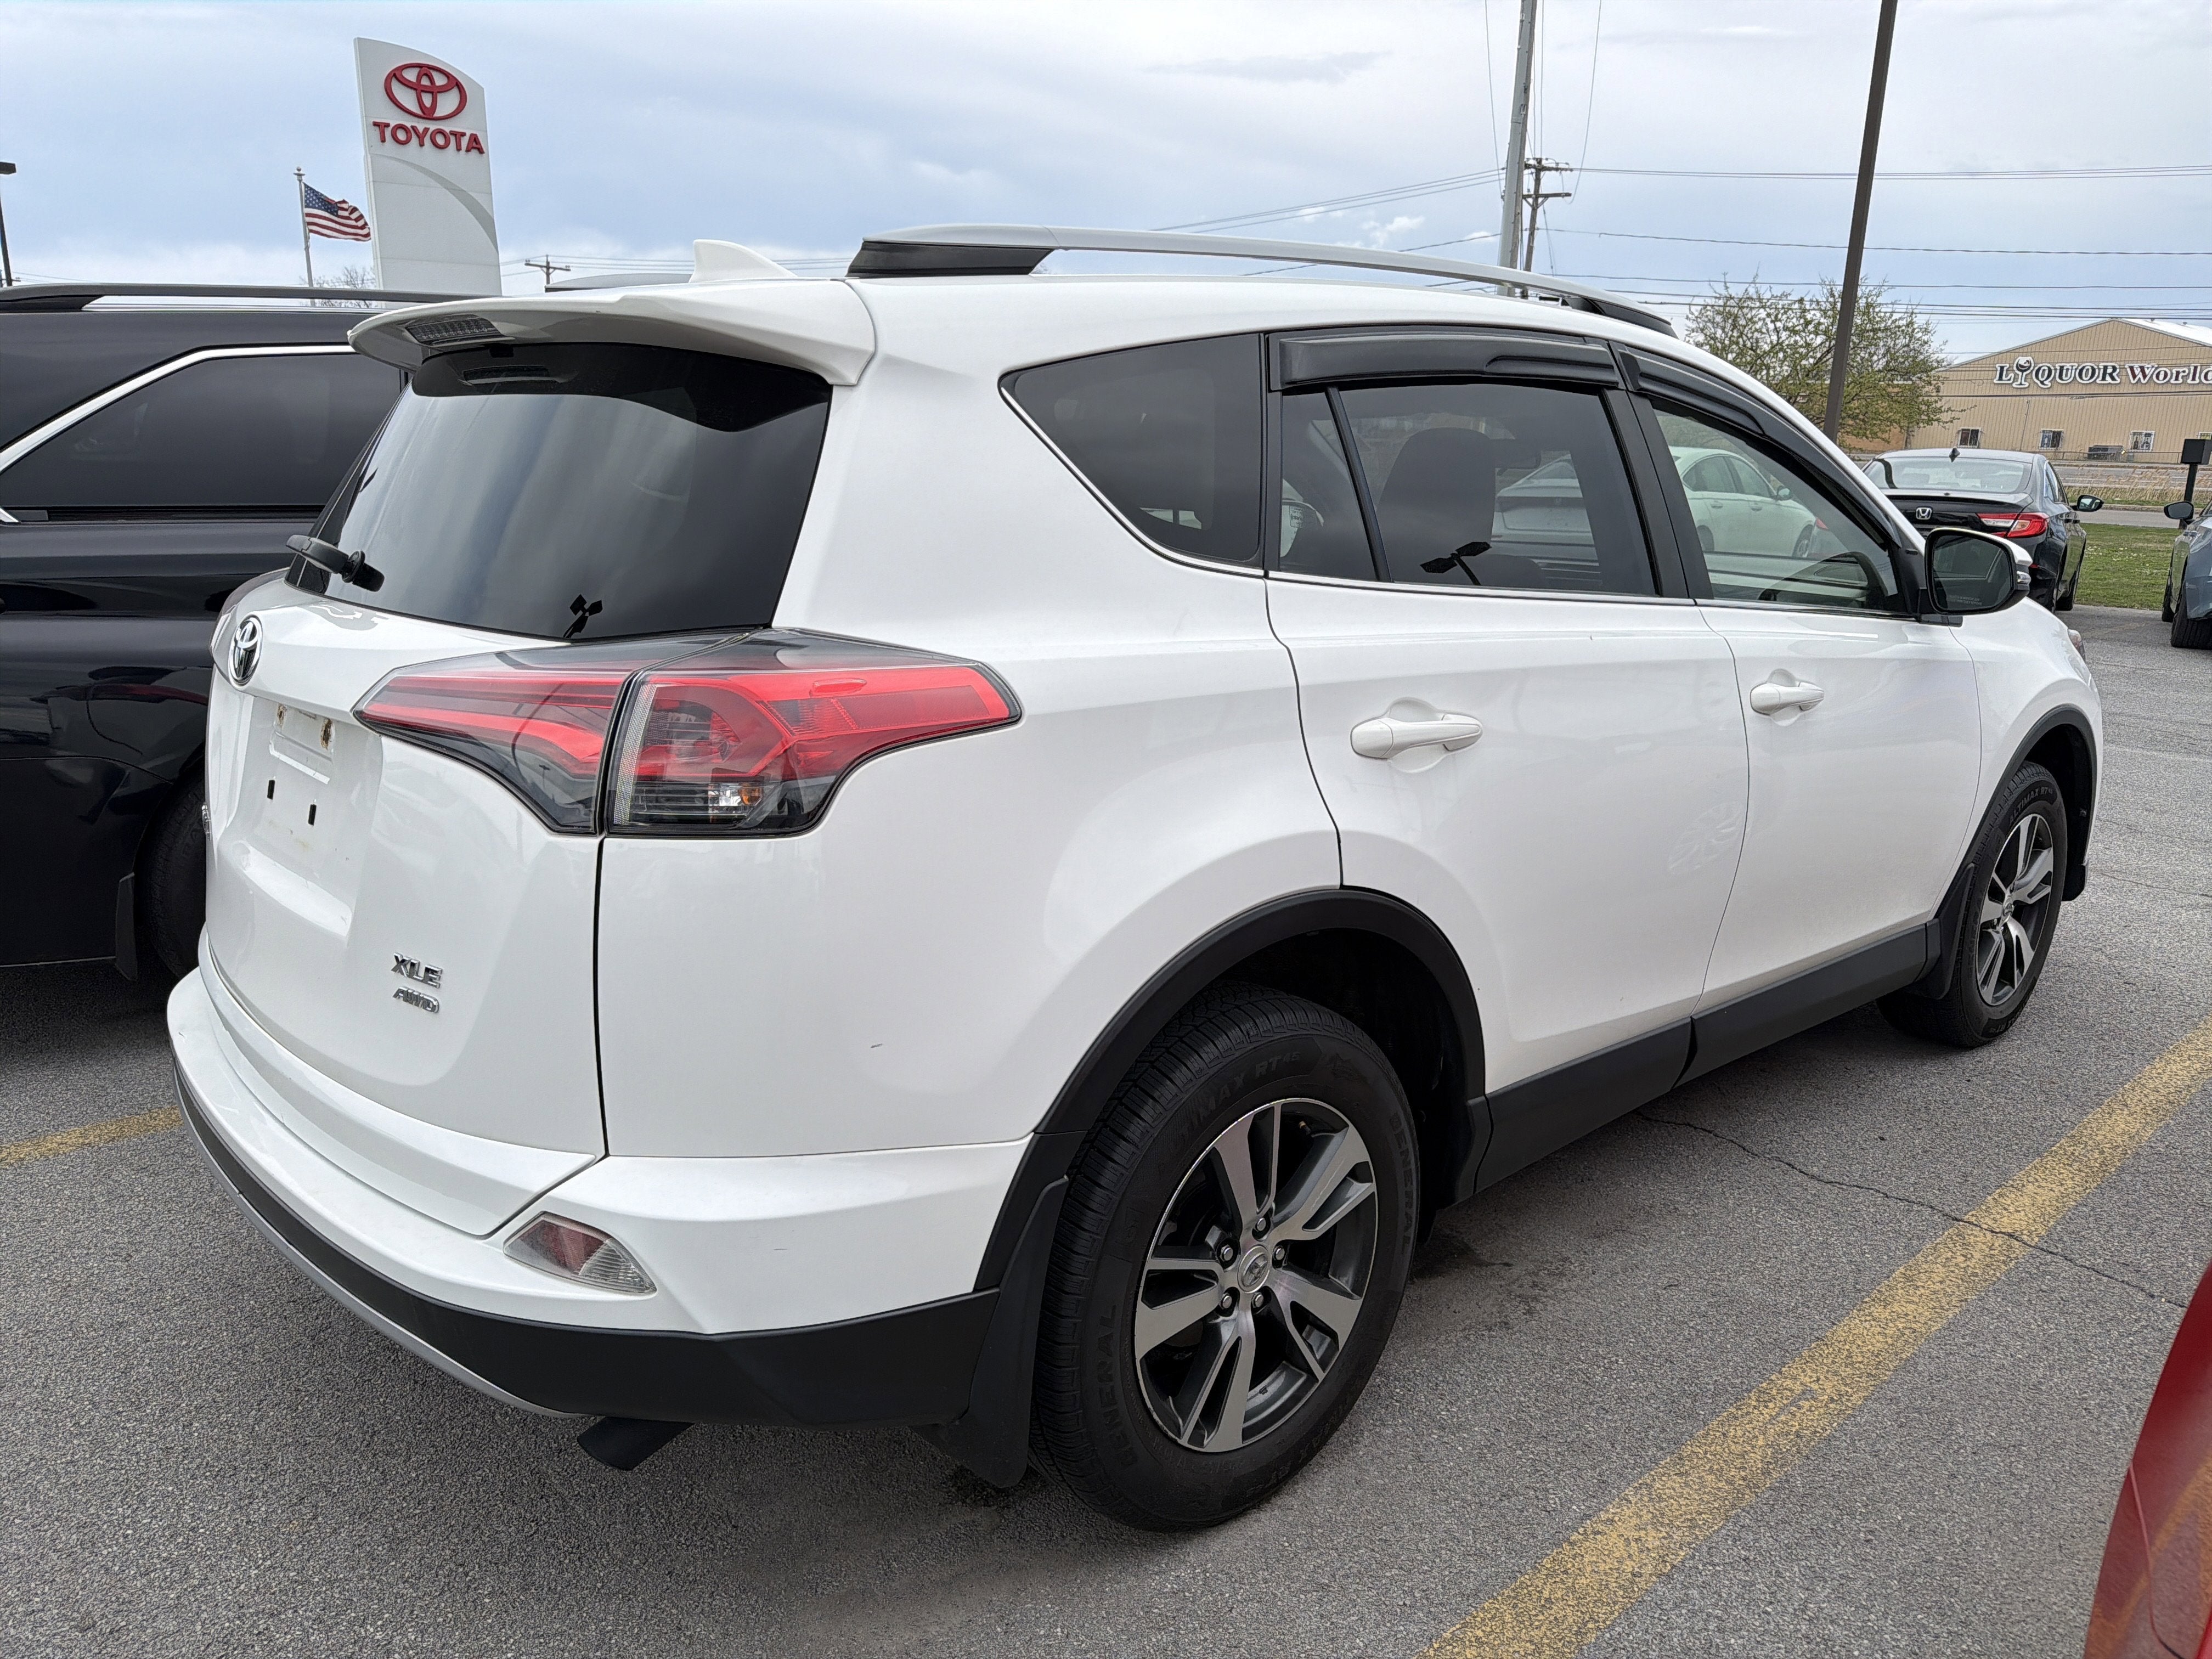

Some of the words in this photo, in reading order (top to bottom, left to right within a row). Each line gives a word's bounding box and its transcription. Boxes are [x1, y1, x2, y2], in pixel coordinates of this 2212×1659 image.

[373, 121, 485, 154] TOYOTA
[1994, 357, 2120, 387] LIQUOR
[391, 952, 443, 989] XLE
[393, 986, 439, 1013] AWD
[1389, 1111, 1413, 1255] GENERAL
[1097, 1305, 1138, 1468] GENERAL
